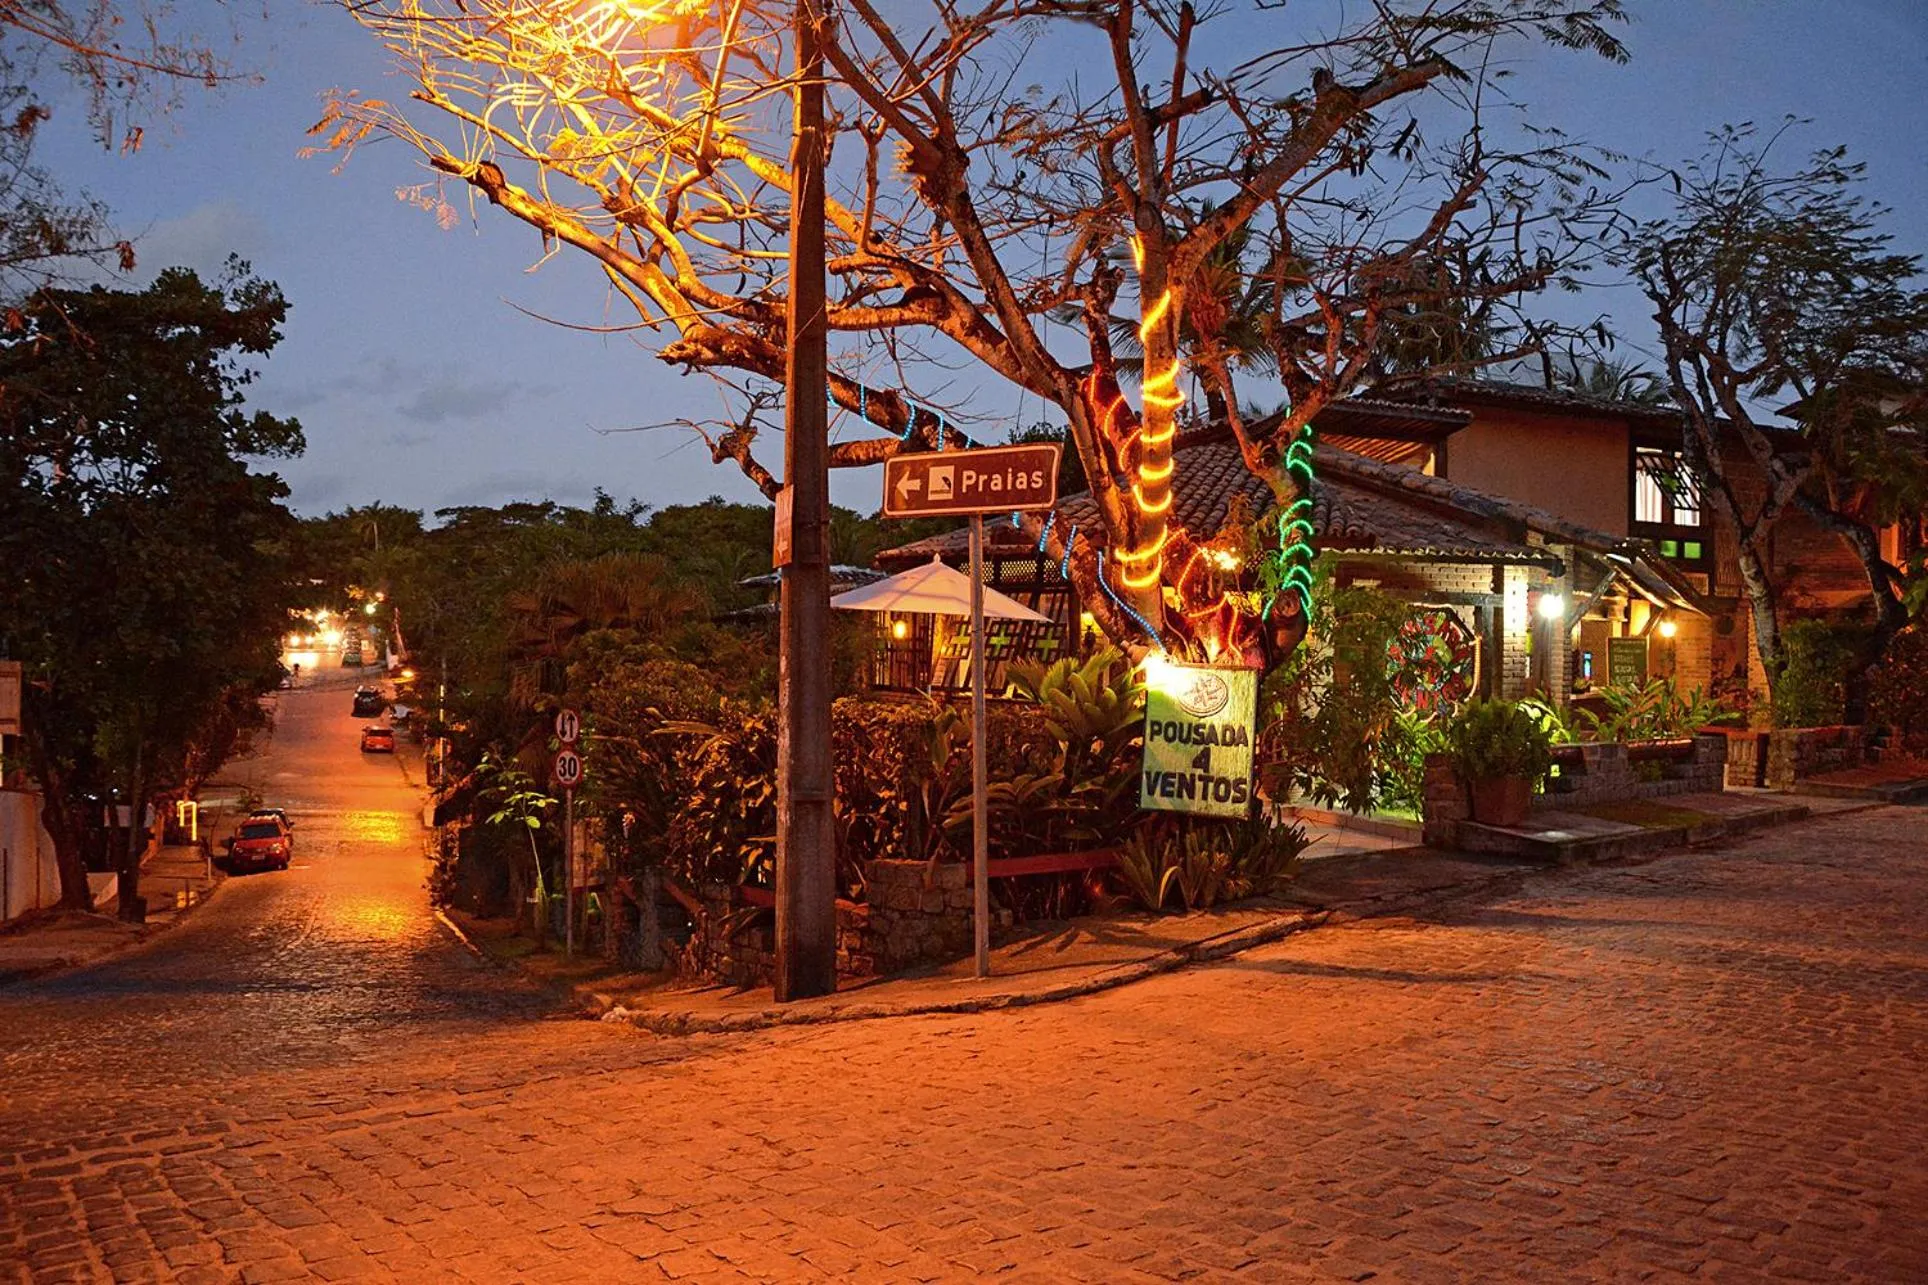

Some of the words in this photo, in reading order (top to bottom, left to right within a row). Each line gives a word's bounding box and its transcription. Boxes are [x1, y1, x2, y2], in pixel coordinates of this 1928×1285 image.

[961, 467, 1044, 494] Praias
[1149, 719, 1249, 747] POUSADA
[558, 756, 578, 778] 30
[1191, 746, 1212, 773] 4
[1143, 770, 1249, 804] VENTOS
